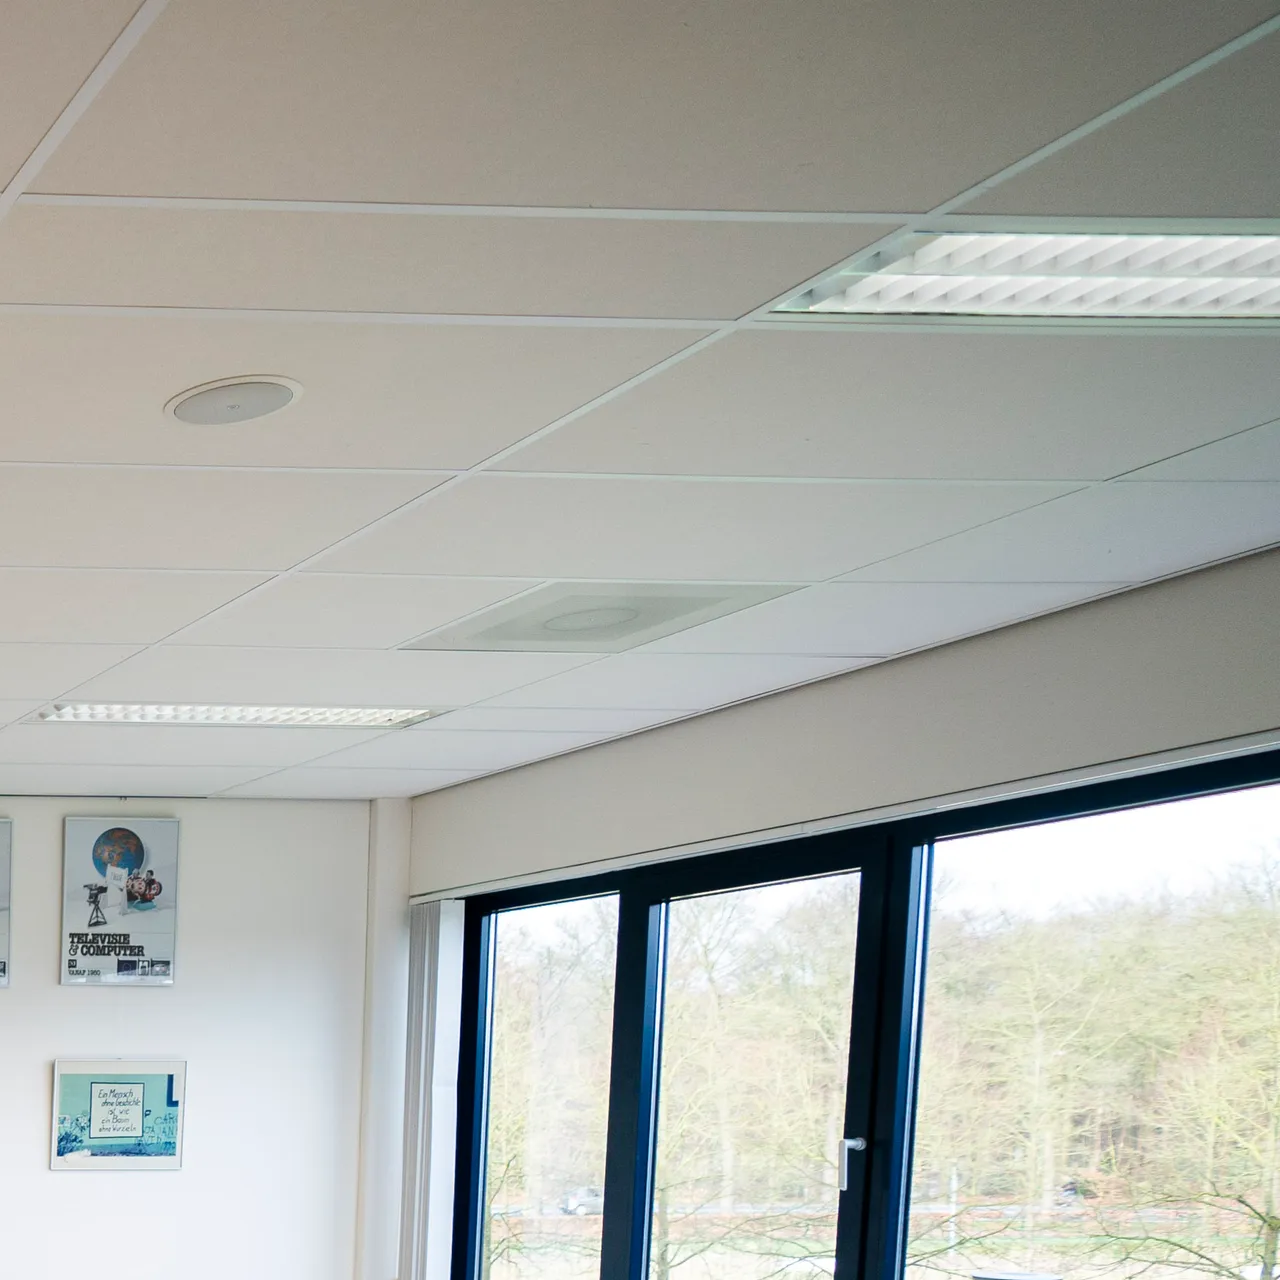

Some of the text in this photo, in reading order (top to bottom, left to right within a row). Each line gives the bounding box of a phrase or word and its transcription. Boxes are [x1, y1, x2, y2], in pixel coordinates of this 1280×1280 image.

[69, 933, 130, 944] TELEVISIE
[69, 944, 145, 956] & COMPUTER
